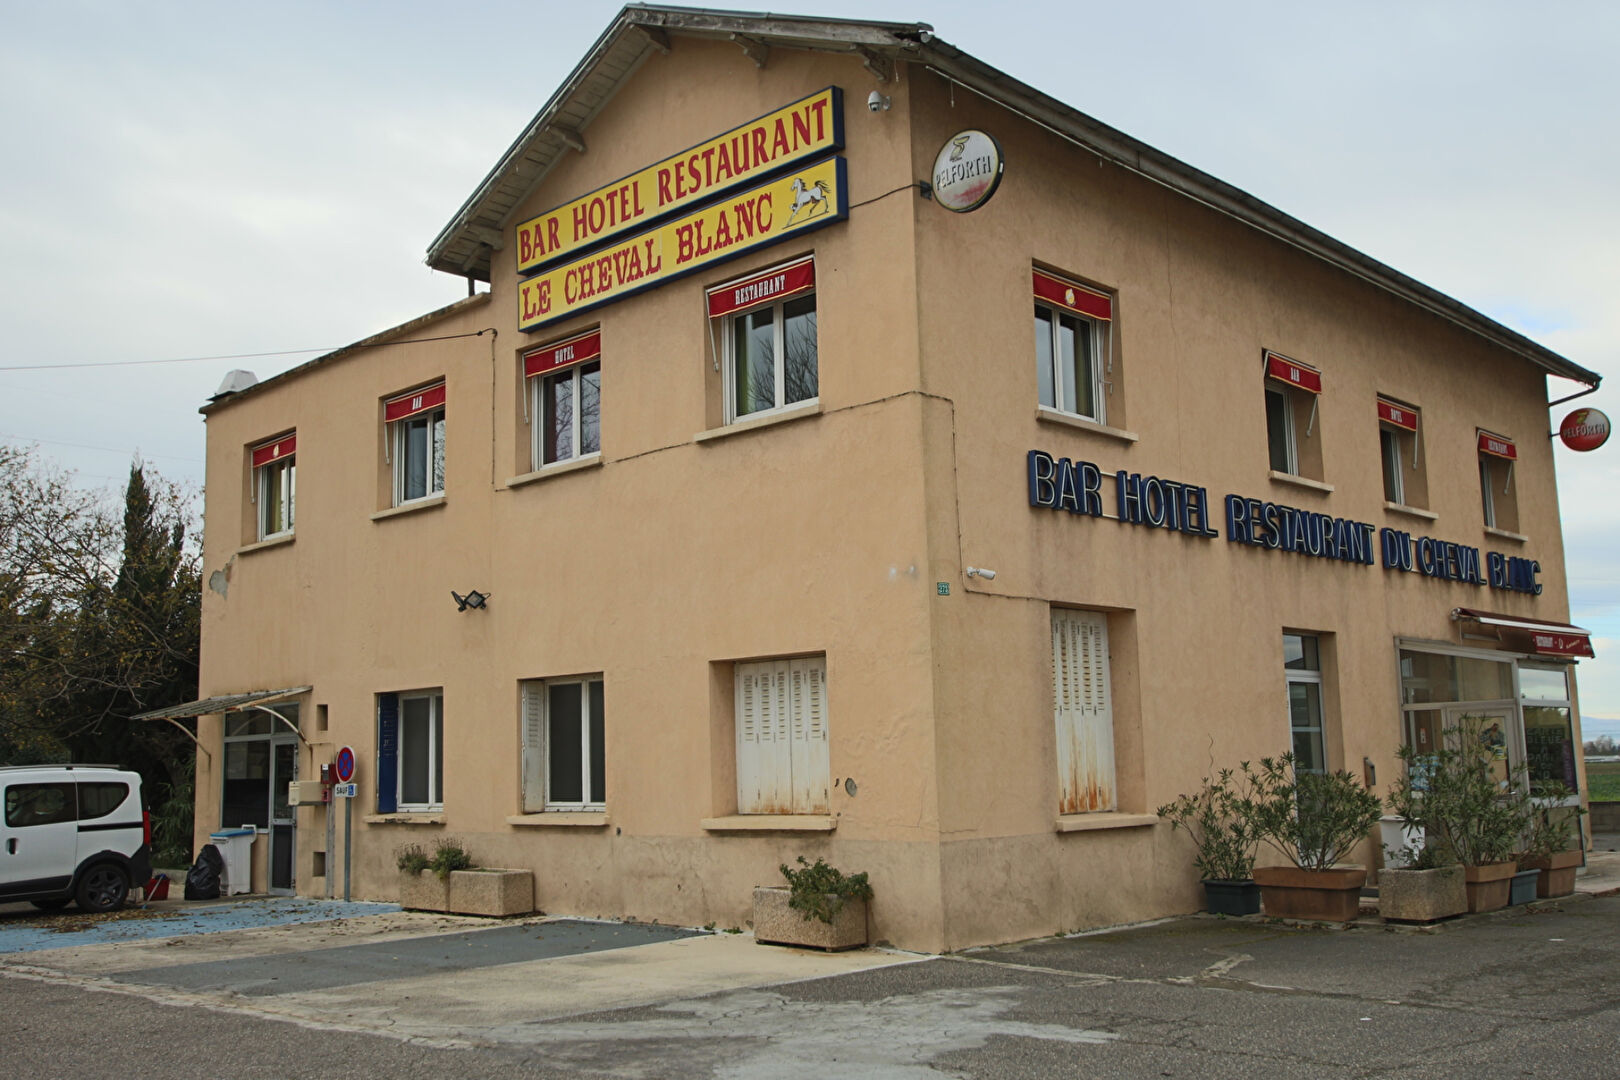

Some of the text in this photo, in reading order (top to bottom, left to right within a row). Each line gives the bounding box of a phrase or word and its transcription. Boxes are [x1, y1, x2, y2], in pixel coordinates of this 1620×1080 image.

[519, 98, 828, 265] BAR HOTEL RESTAURANT
[935, 155, 992, 191] PELFORTH
[522, 192, 774, 322] LE CHEVAL BLANC
[734, 274, 787, 306] RESTAURANT
[554, 345, 575, 364] HOTEL
[1027, 449, 1103, 518] BAR
[1117, 470, 1219, 538] HOTEL
[1225, 493, 1376, 566] RESTAURANT
[1380, 526, 1413, 572] DU
[1417, 535, 1487, 587] CHEVAL
